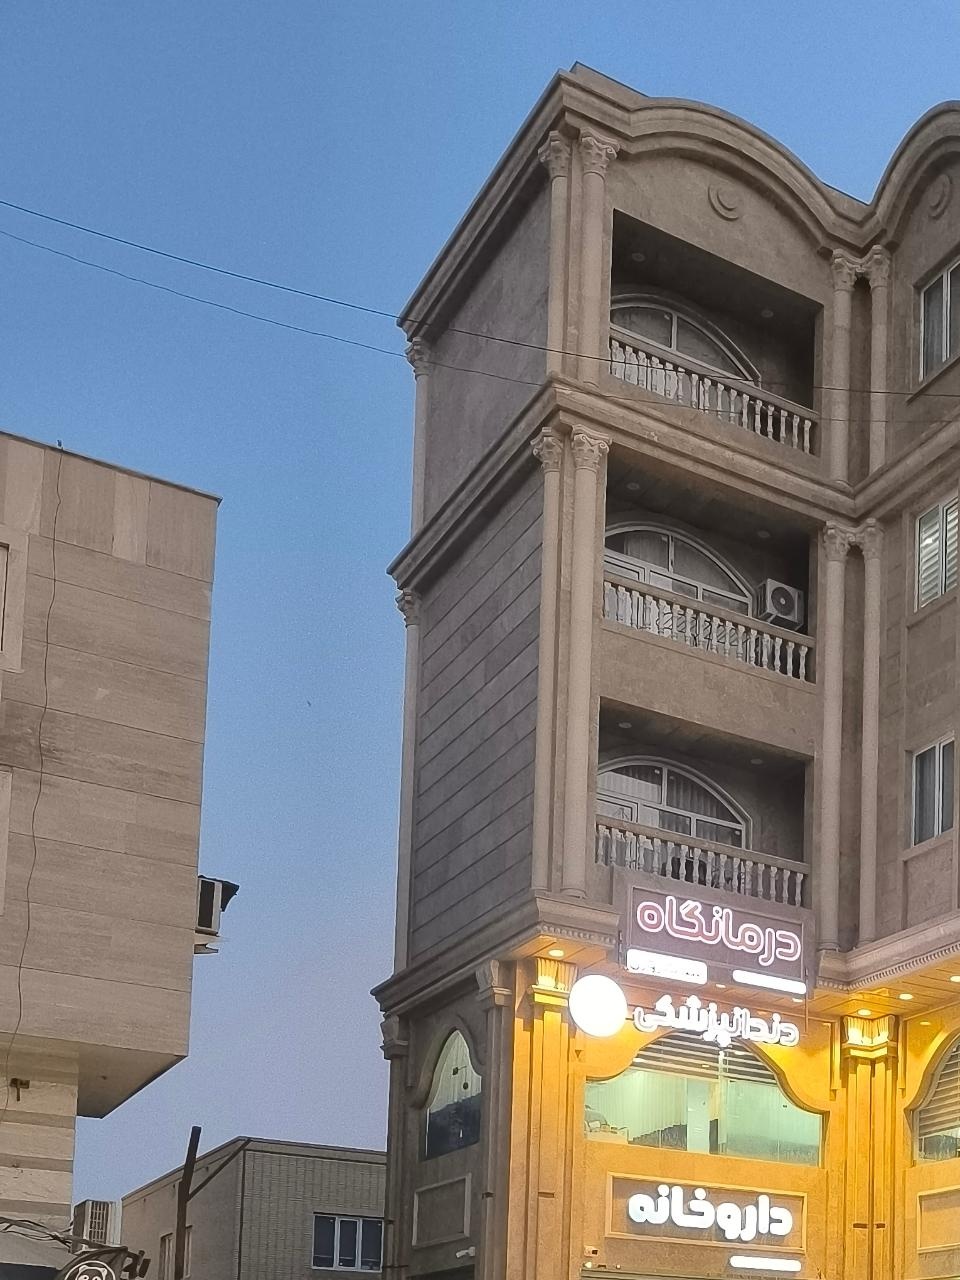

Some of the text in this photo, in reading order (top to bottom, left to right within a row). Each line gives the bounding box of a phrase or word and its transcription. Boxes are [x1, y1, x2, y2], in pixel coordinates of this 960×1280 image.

[636, 895, 801, 967] درمانگاه
[633, 994, 800, 1048] دندانپزشکی
[627, 1184, 793, 1242] داروخانه
